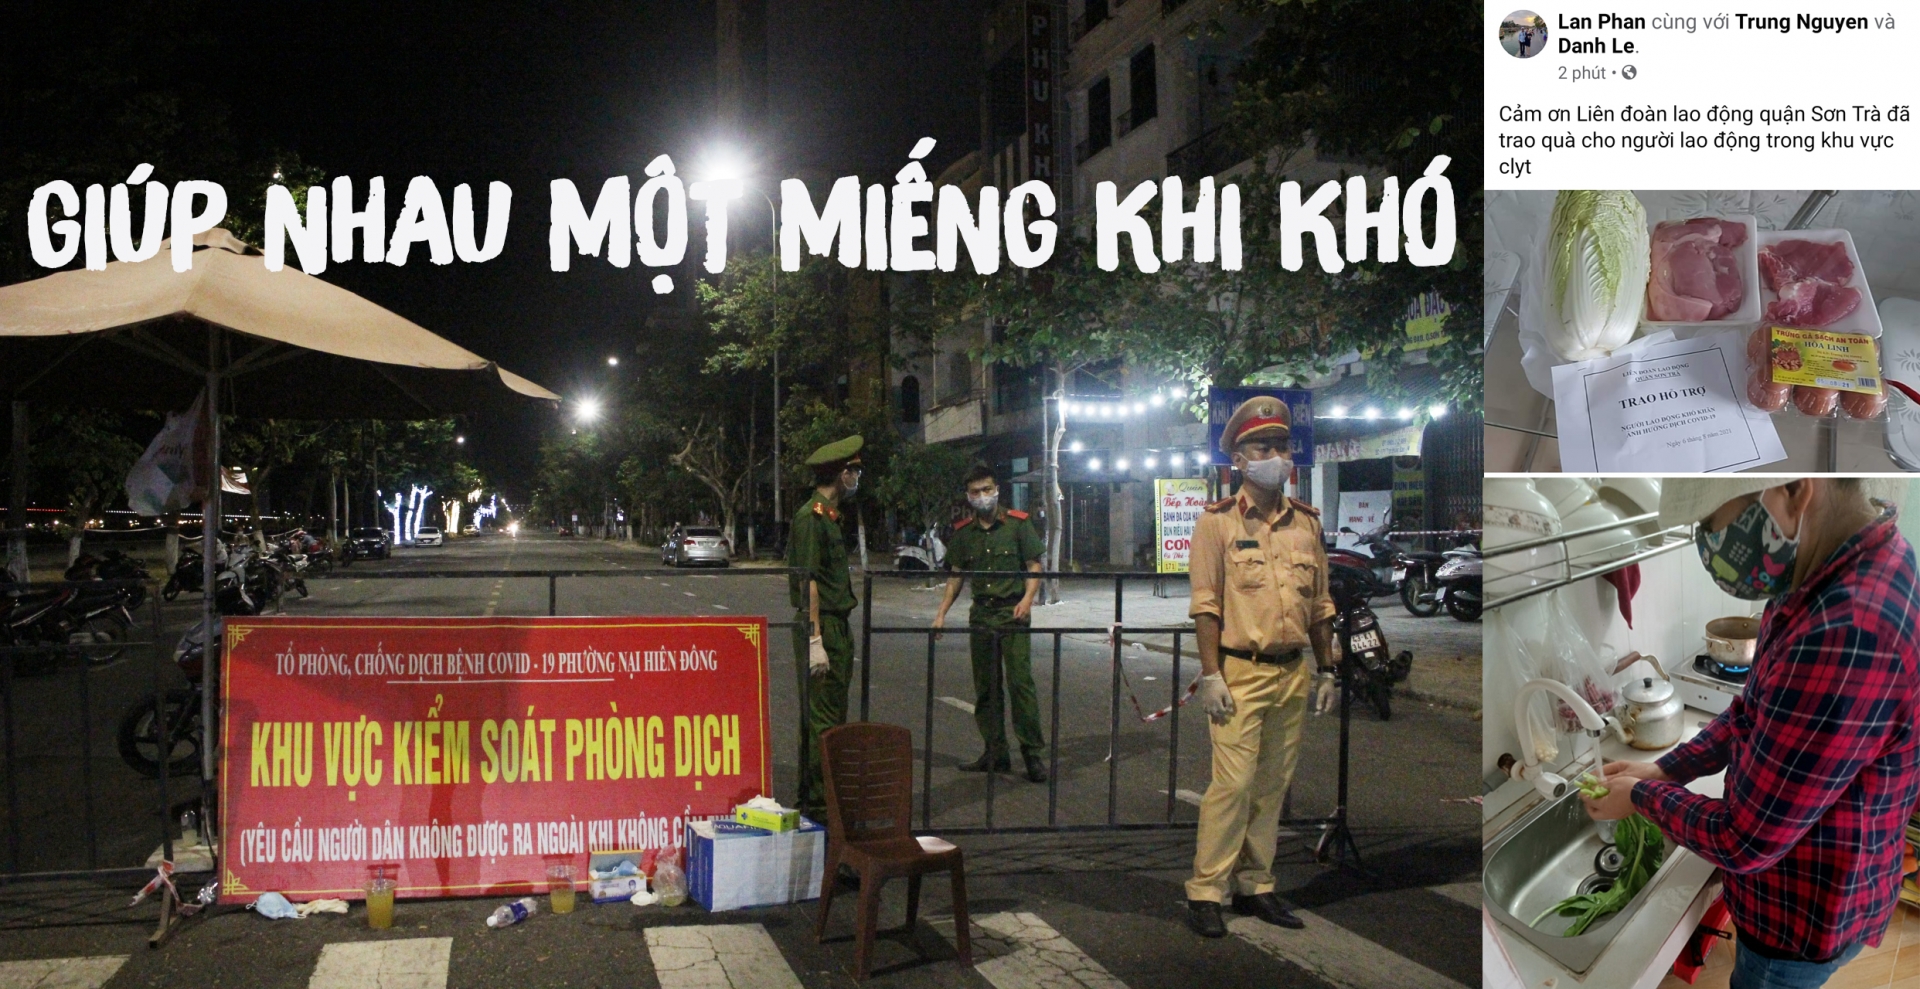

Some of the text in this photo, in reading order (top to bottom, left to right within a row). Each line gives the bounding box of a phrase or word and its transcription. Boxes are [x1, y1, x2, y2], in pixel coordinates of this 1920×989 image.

[1776, 329, 1801, 339] TRỨNG
[1802, 332, 1814, 340] GÀ
[1848, 337, 1869, 345] TOÀN
[1827, 345, 1850, 353] LINH
[1619, 385, 1706, 409] TRAO HỖ TRỢ
[1645, 418, 1660, 426] LAO
[1661, 413, 1680, 423] ĐỘNG
[1669, 420, 1686, 429] DỊCH
[1687, 414, 1716, 425] COVID-19
[1666, 440, 1681, 449] Ngày
[1687, 435, 1702, 444] tháng
[1707, 431, 1719, 439] năm
[1719, 428, 1732, 437] 2021
[276, 641, 295, 675] TỔ
[298, 647, 352, 679] PHÒNG,
[354, 641, 405, 676] CHỐNG
[408, 652, 443, 682] DỊCH
[447, 647, 485, 682] BỆNH
[487, 652, 531, 674] COVID
[542, 652, 555, 674] 19
[558, 645, 615, 674] PHƯỜNG
[618, 650, 641, 680] NẠI
[643, 645, 677, 672] HIÊN
[679, 644, 718, 672] ĐÔNG
[251, 693, 741, 802] KHU VỰC KIỂM SOÁT PHÒNG DỊCH
[240, 821, 277, 867] (YÊU
[281, 816, 313, 863] CẦU
[318, 818, 367, 862] NGƯỜI
[371, 819, 405, 861] DÂN
[409, 818, 462, 860] KHÔNG
[467, 819, 508, 865] ĐƯỢC
[513, 822, 533, 856] RA
[537, 814, 584, 855] NGOÀI
[589, 818, 614, 852] KHI
[618, 811, 668, 851] KHÔNG
